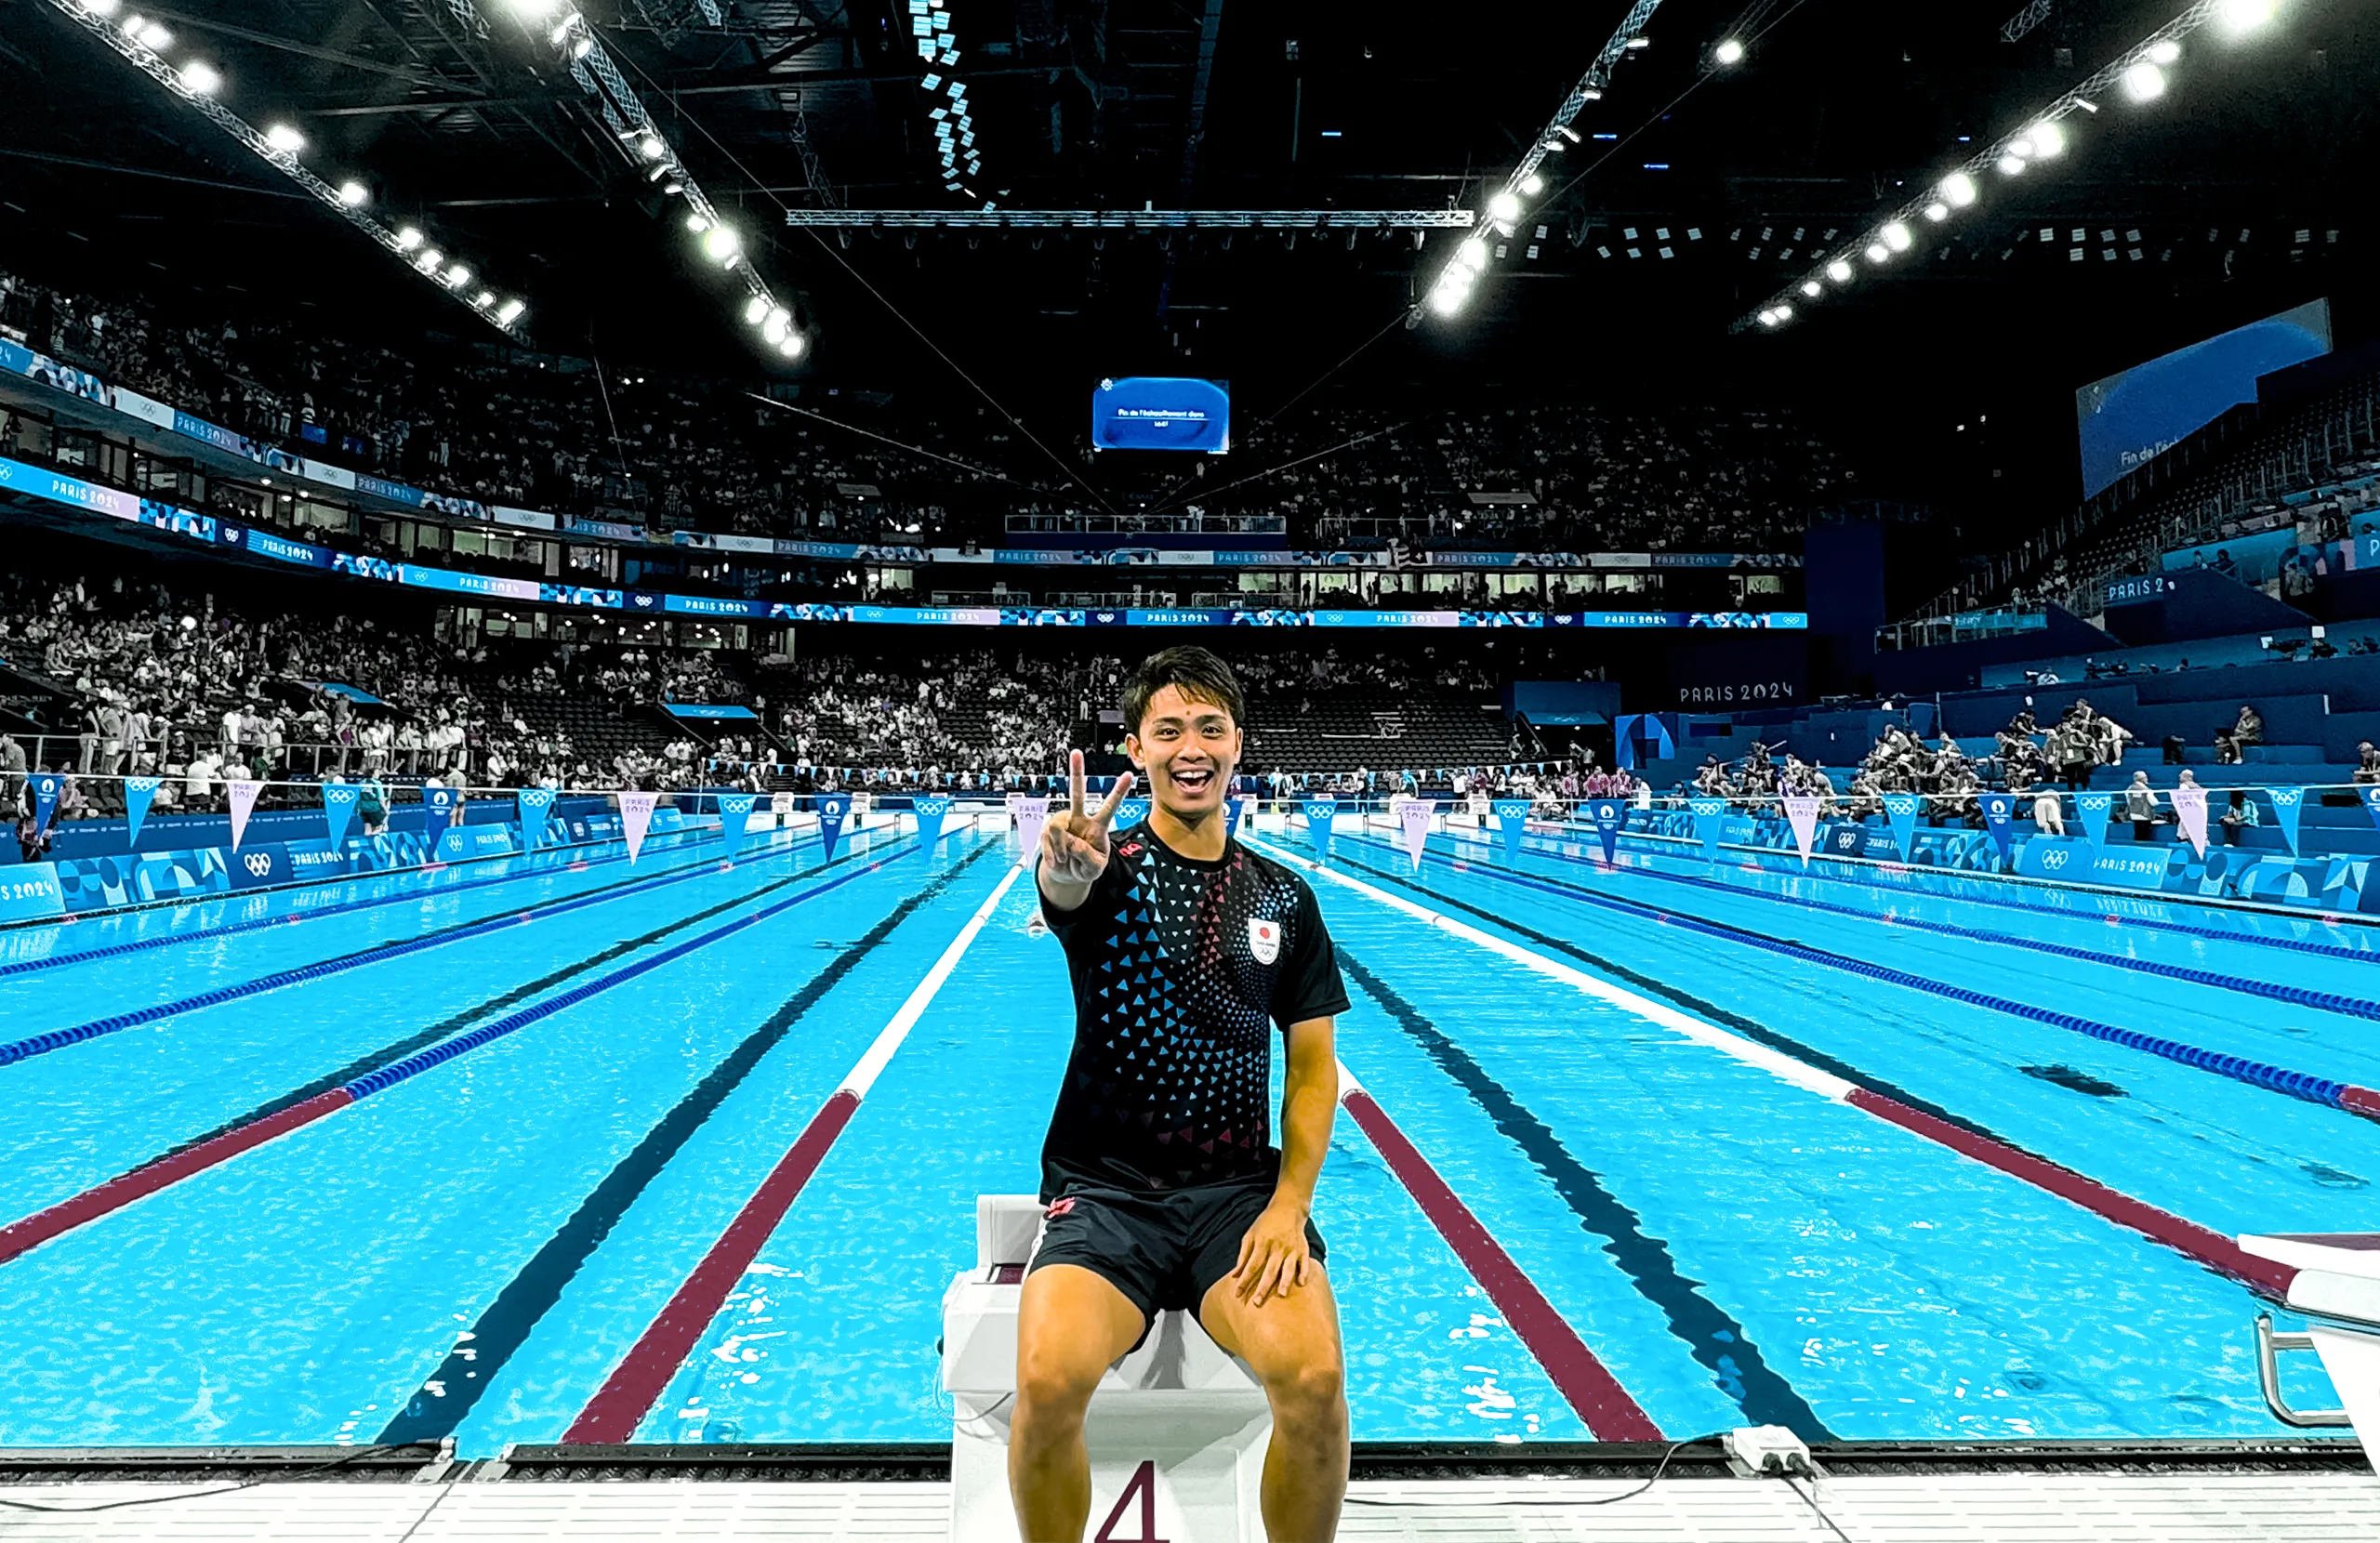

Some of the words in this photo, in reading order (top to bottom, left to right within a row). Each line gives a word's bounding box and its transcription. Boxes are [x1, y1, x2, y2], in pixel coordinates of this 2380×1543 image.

[178, 416, 205, 436] PARIS
[2121, 451, 2138, 467] Fin
[2139, 444, 2154, 461] de
[52, 480, 86, 500] PARIS
[90, 490, 119, 510] 2024
[358, 478, 386, 494] PARIS
[387, 486, 411, 499] 2024
[262, 539, 285, 555] PARIS
[287, 546, 313, 561] 2024
[777, 542, 808, 552] PARIS
[812, 546, 840, 554] 2024
[999, 552, 1030, 560] PARIS
[1034, 553, 1062, 561] 2024
[1472, 555, 1499, 563] 2024
[459, 577, 488, 590] PARIS
[491, 581, 520, 593] 2024
[2109, 579, 2150, 601] PARIS
[685, 600, 715, 611] PARIS
[719, 602, 748, 613] 2024
[917, 612, 948, 621] PARIS
[951, 613, 980, 621] 2024
[1146, 613, 1179, 623] PARIS
[1181, 613, 1210, 623] 2024
[1376, 614, 1408, 623] PARIS
[1410, 614, 1438, 623] 2024
[1605, 615, 1635, 624] PARIS
[1638, 615, 1667, 625] 2024
[1680, 685, 1733, 703] PARIS
[1740, 681, 1792, 701] 2024
[295, 852, 321, 865] PARIS
[2128, 860, 2161, 876] 2024
[13, 880, 55, 900] 2024
[1094, 1460, 1170, 1543] 4
